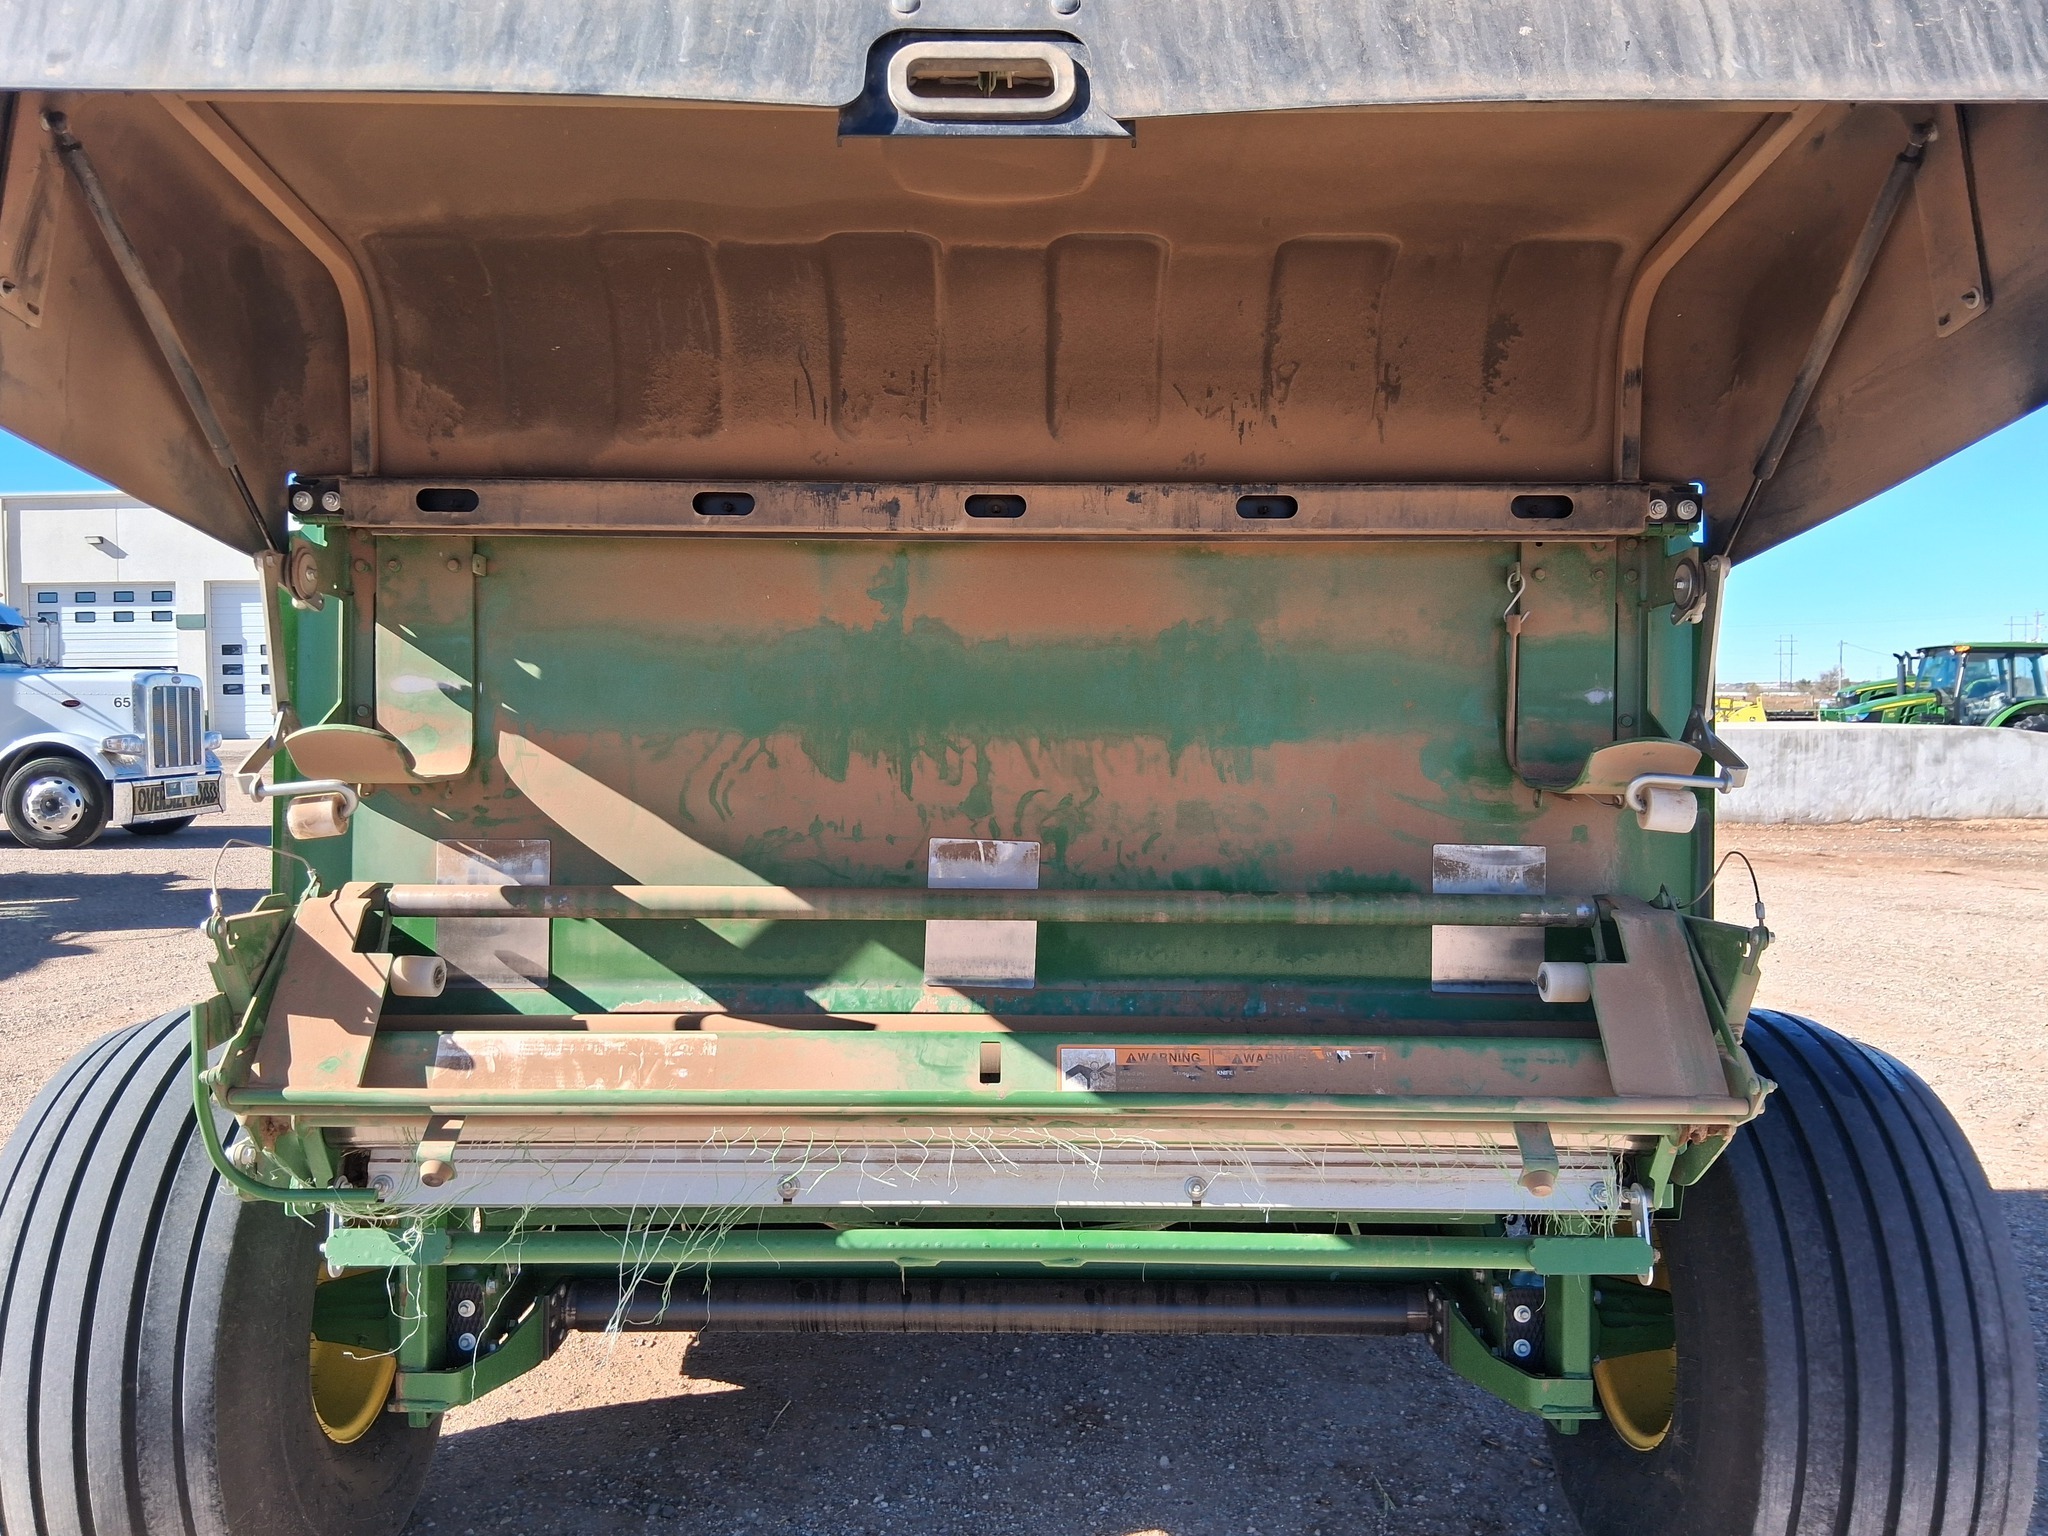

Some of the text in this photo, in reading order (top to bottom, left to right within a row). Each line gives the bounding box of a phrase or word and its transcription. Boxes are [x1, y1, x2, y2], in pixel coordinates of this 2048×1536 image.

[113, 697, 131, 708] 65
[1137, 1052, 1201, 1063] WARNING
[1243, 1053, 1306, 1064] WARNI
